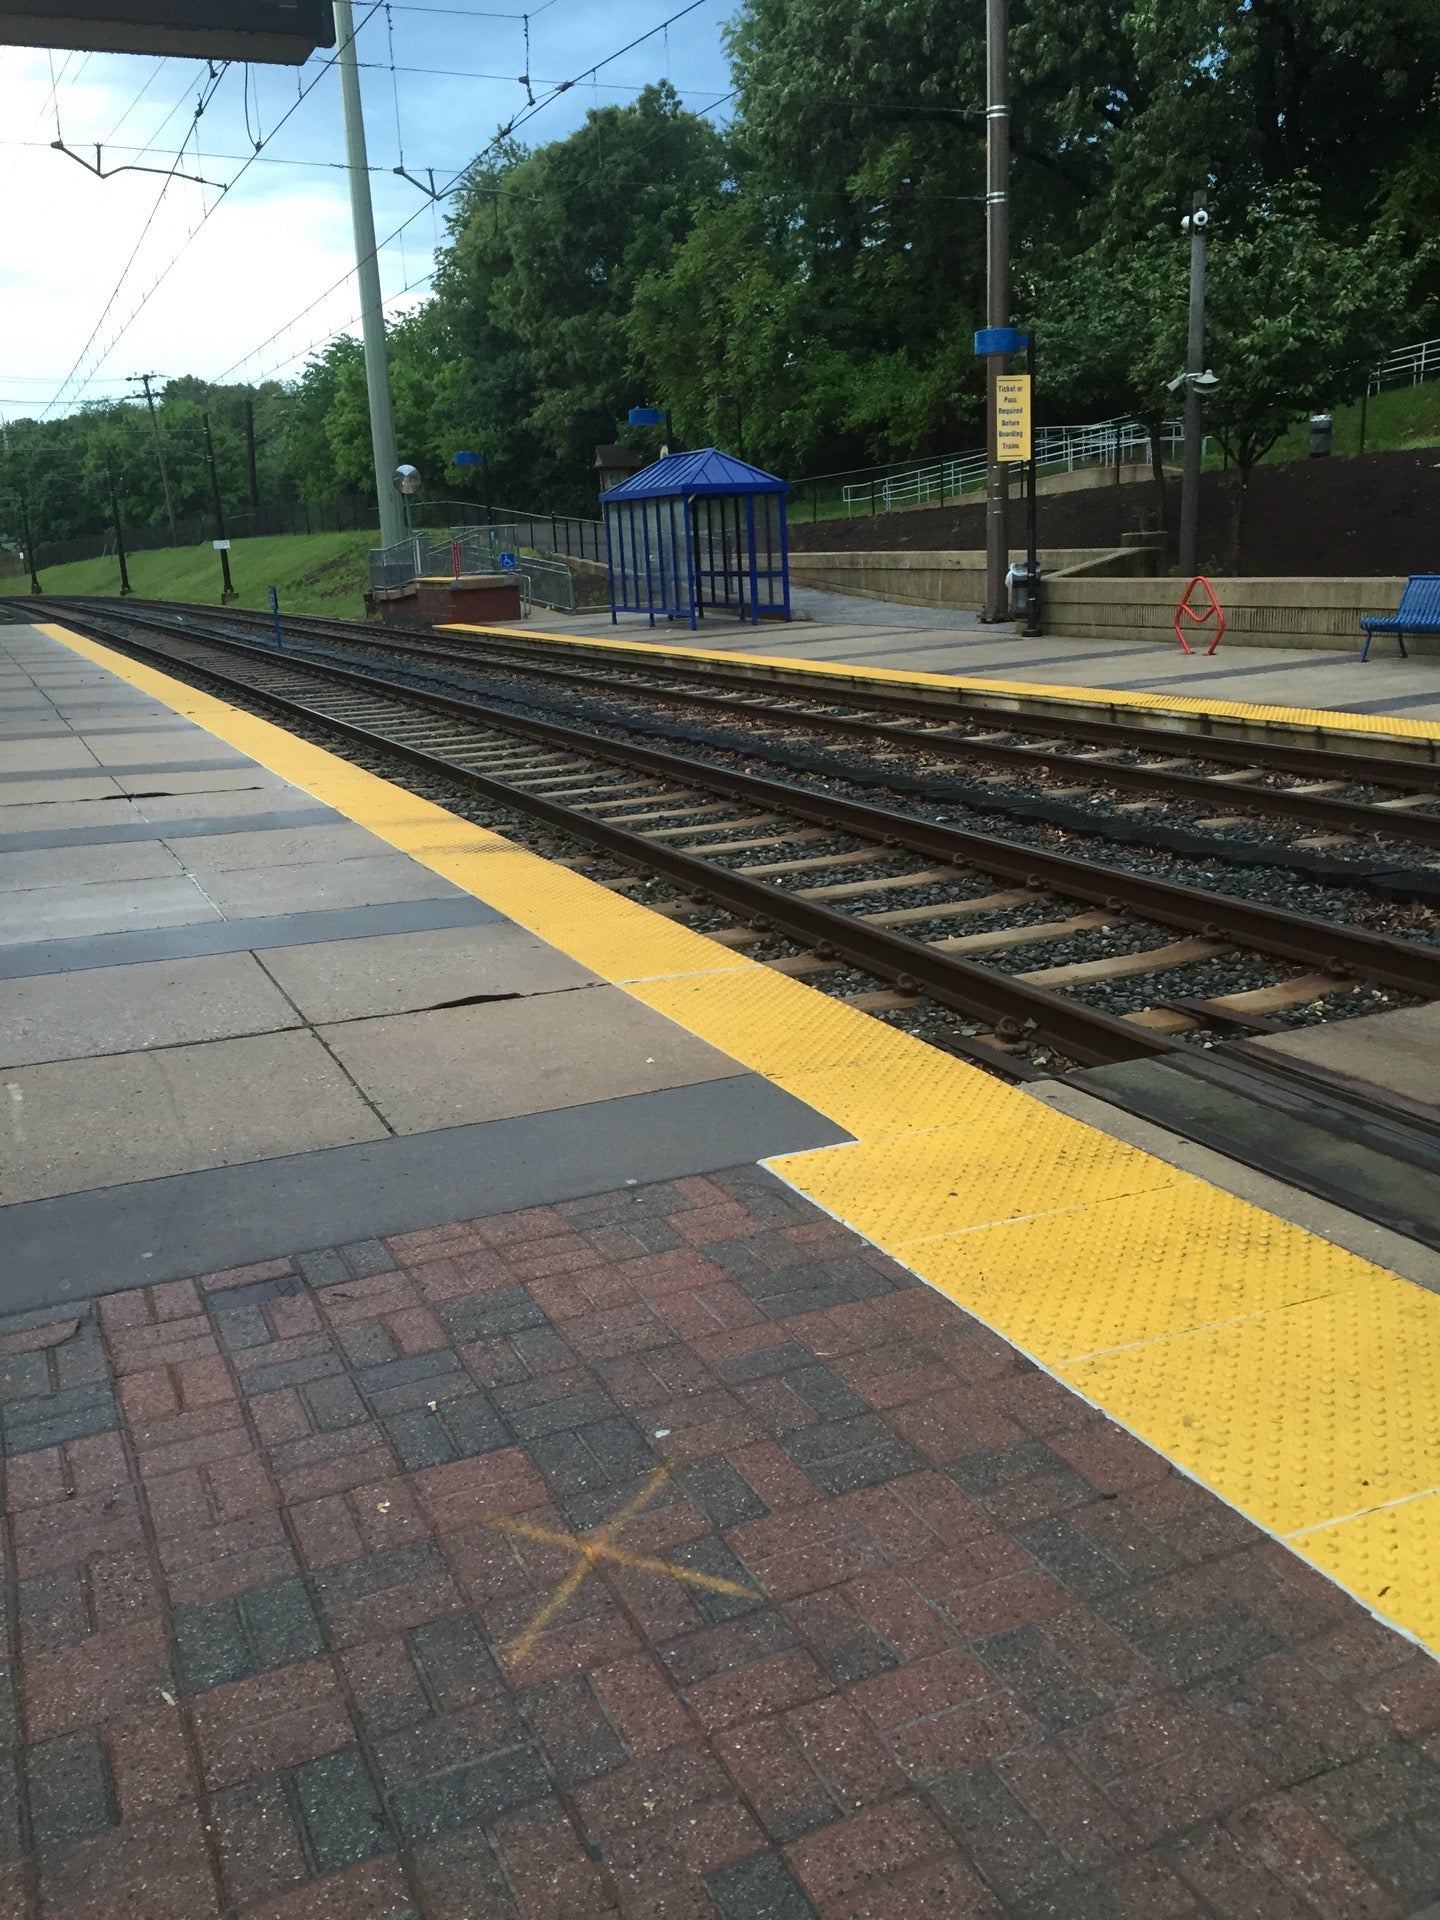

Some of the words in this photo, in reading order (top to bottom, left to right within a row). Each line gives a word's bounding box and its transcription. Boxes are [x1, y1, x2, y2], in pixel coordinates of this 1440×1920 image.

[998, 407, 1023, 416] Required
[998, 430, 1023, 439] Boarding
[1002, 442, 1019, 450] Trains
